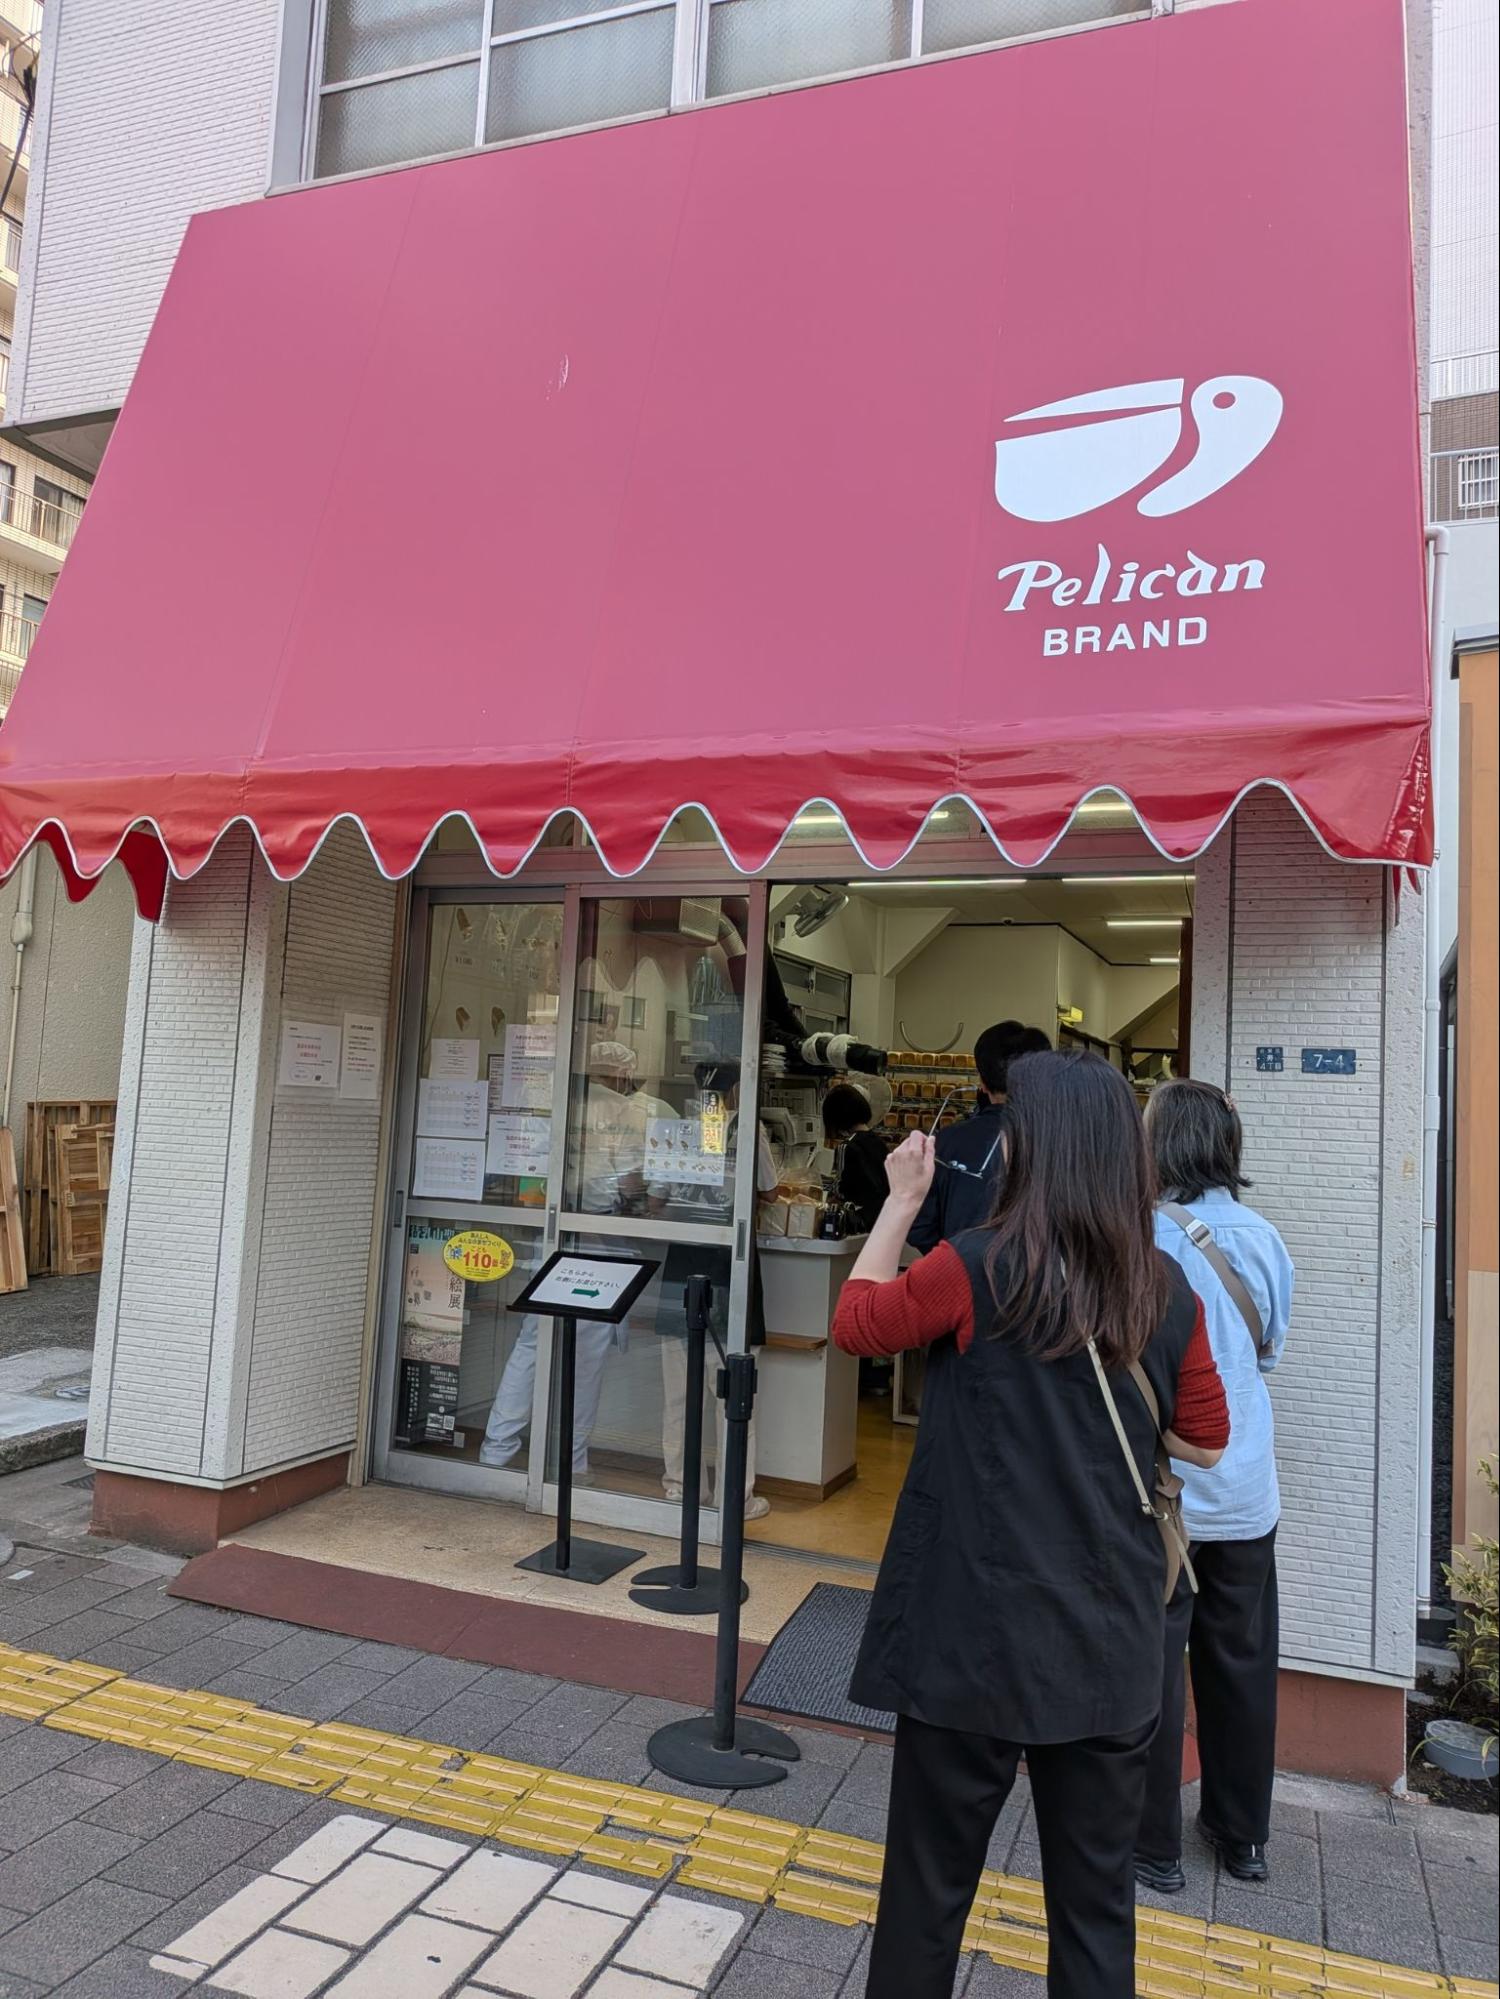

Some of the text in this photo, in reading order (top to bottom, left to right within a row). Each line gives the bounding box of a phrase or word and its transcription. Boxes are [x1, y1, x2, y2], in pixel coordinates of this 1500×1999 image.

[997, 542, 1266, 612] Pelican
[1042, 616, 1208, 657] BRAND
[1312, 1054, 1345, 1069] 7-4
